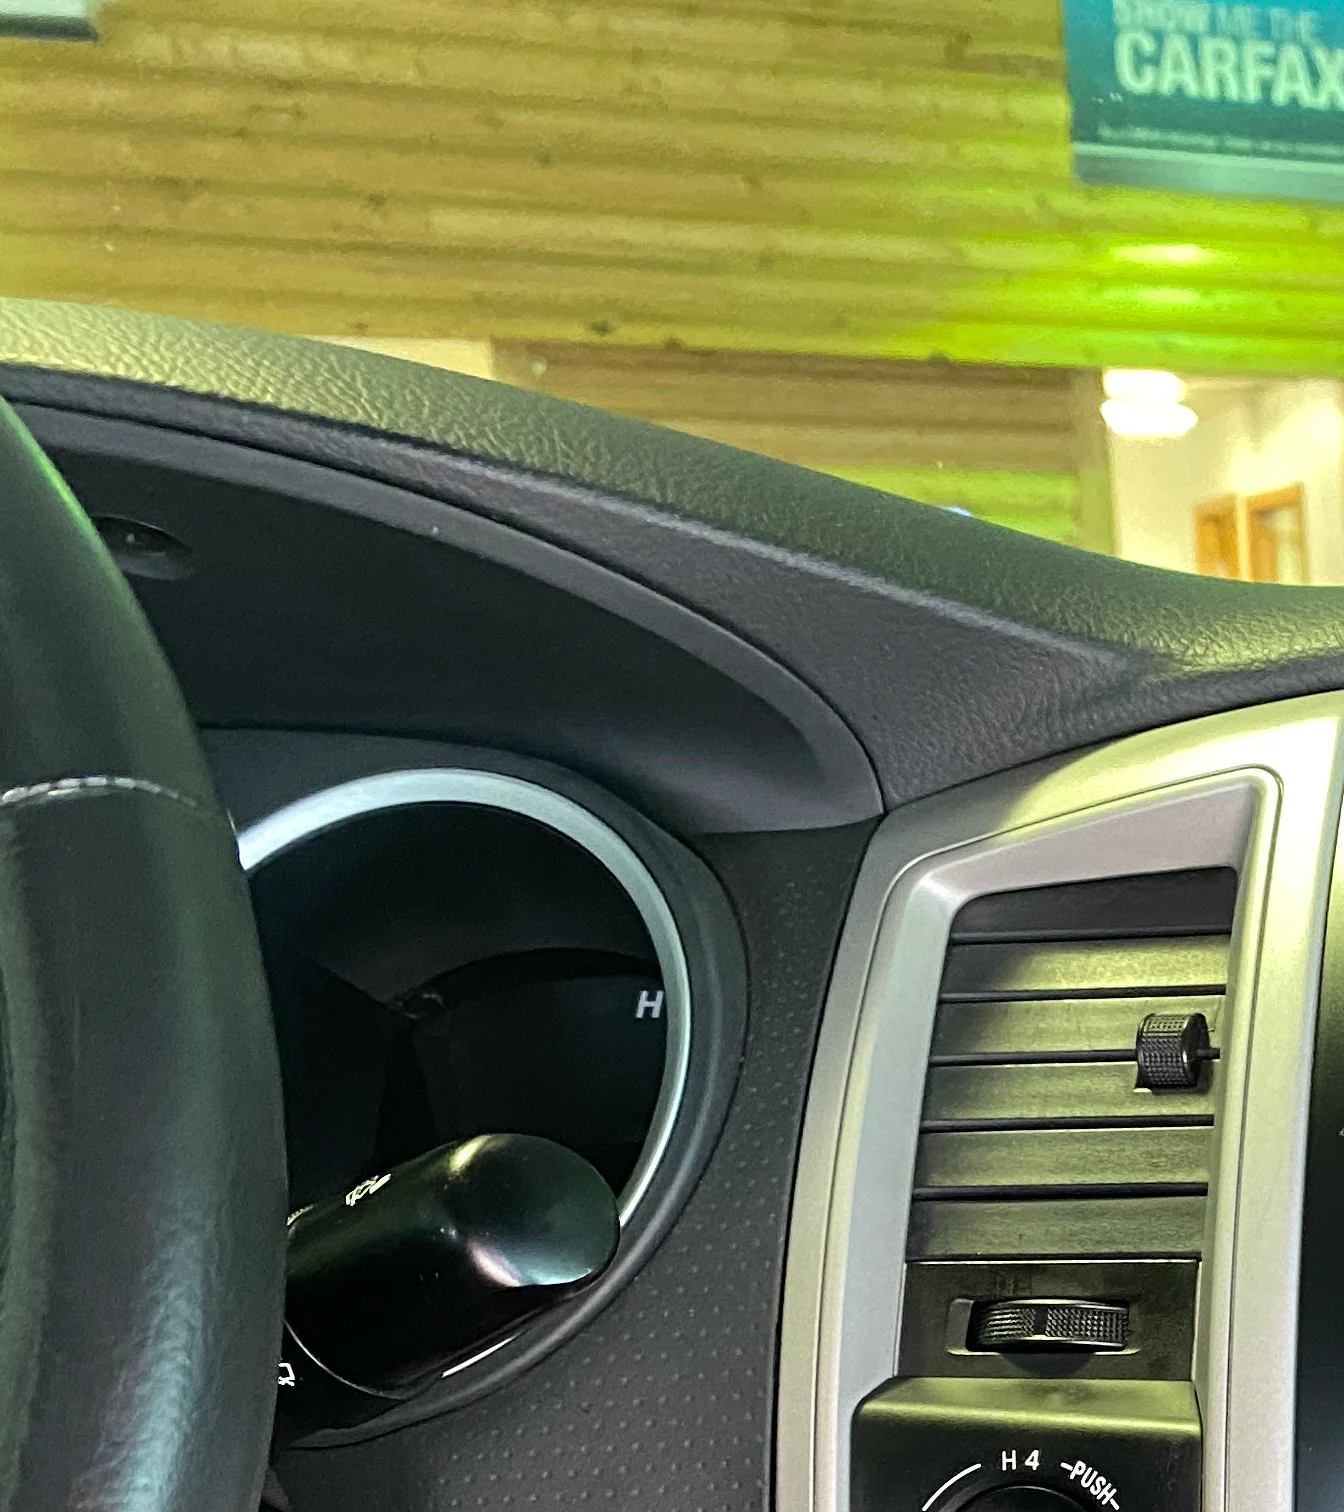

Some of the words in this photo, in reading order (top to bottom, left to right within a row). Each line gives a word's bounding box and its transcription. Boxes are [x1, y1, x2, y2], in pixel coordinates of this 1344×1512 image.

[635, 990, 664, 1019] H
[1001, 1450, 1017, 1472] H
[1024, 1448, 1041, 1472] 4
